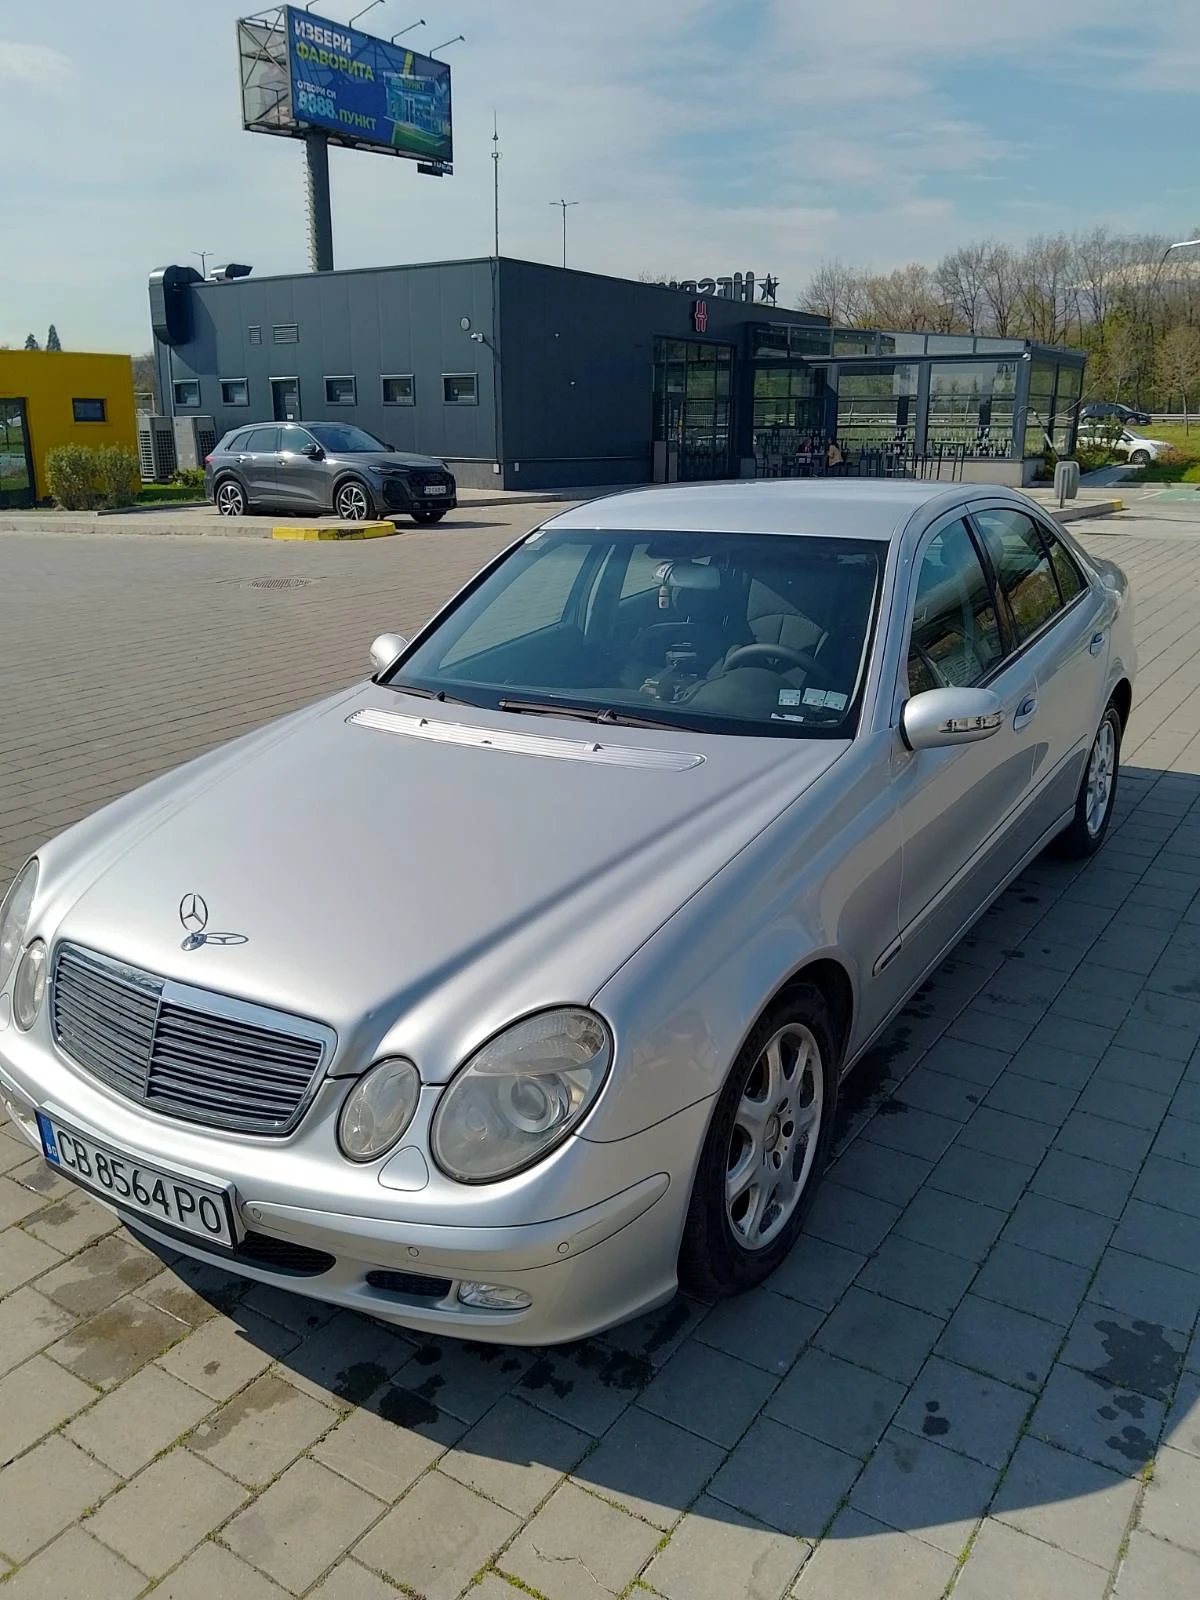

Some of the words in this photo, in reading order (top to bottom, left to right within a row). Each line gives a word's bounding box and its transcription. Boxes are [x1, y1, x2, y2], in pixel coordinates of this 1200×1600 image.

[294, 19, 351, 54] ИЗБЕРИ
[297, 41, 375, 81] ФАВОРИТА
[297, 79, 326, 96] ОТВОРИ
